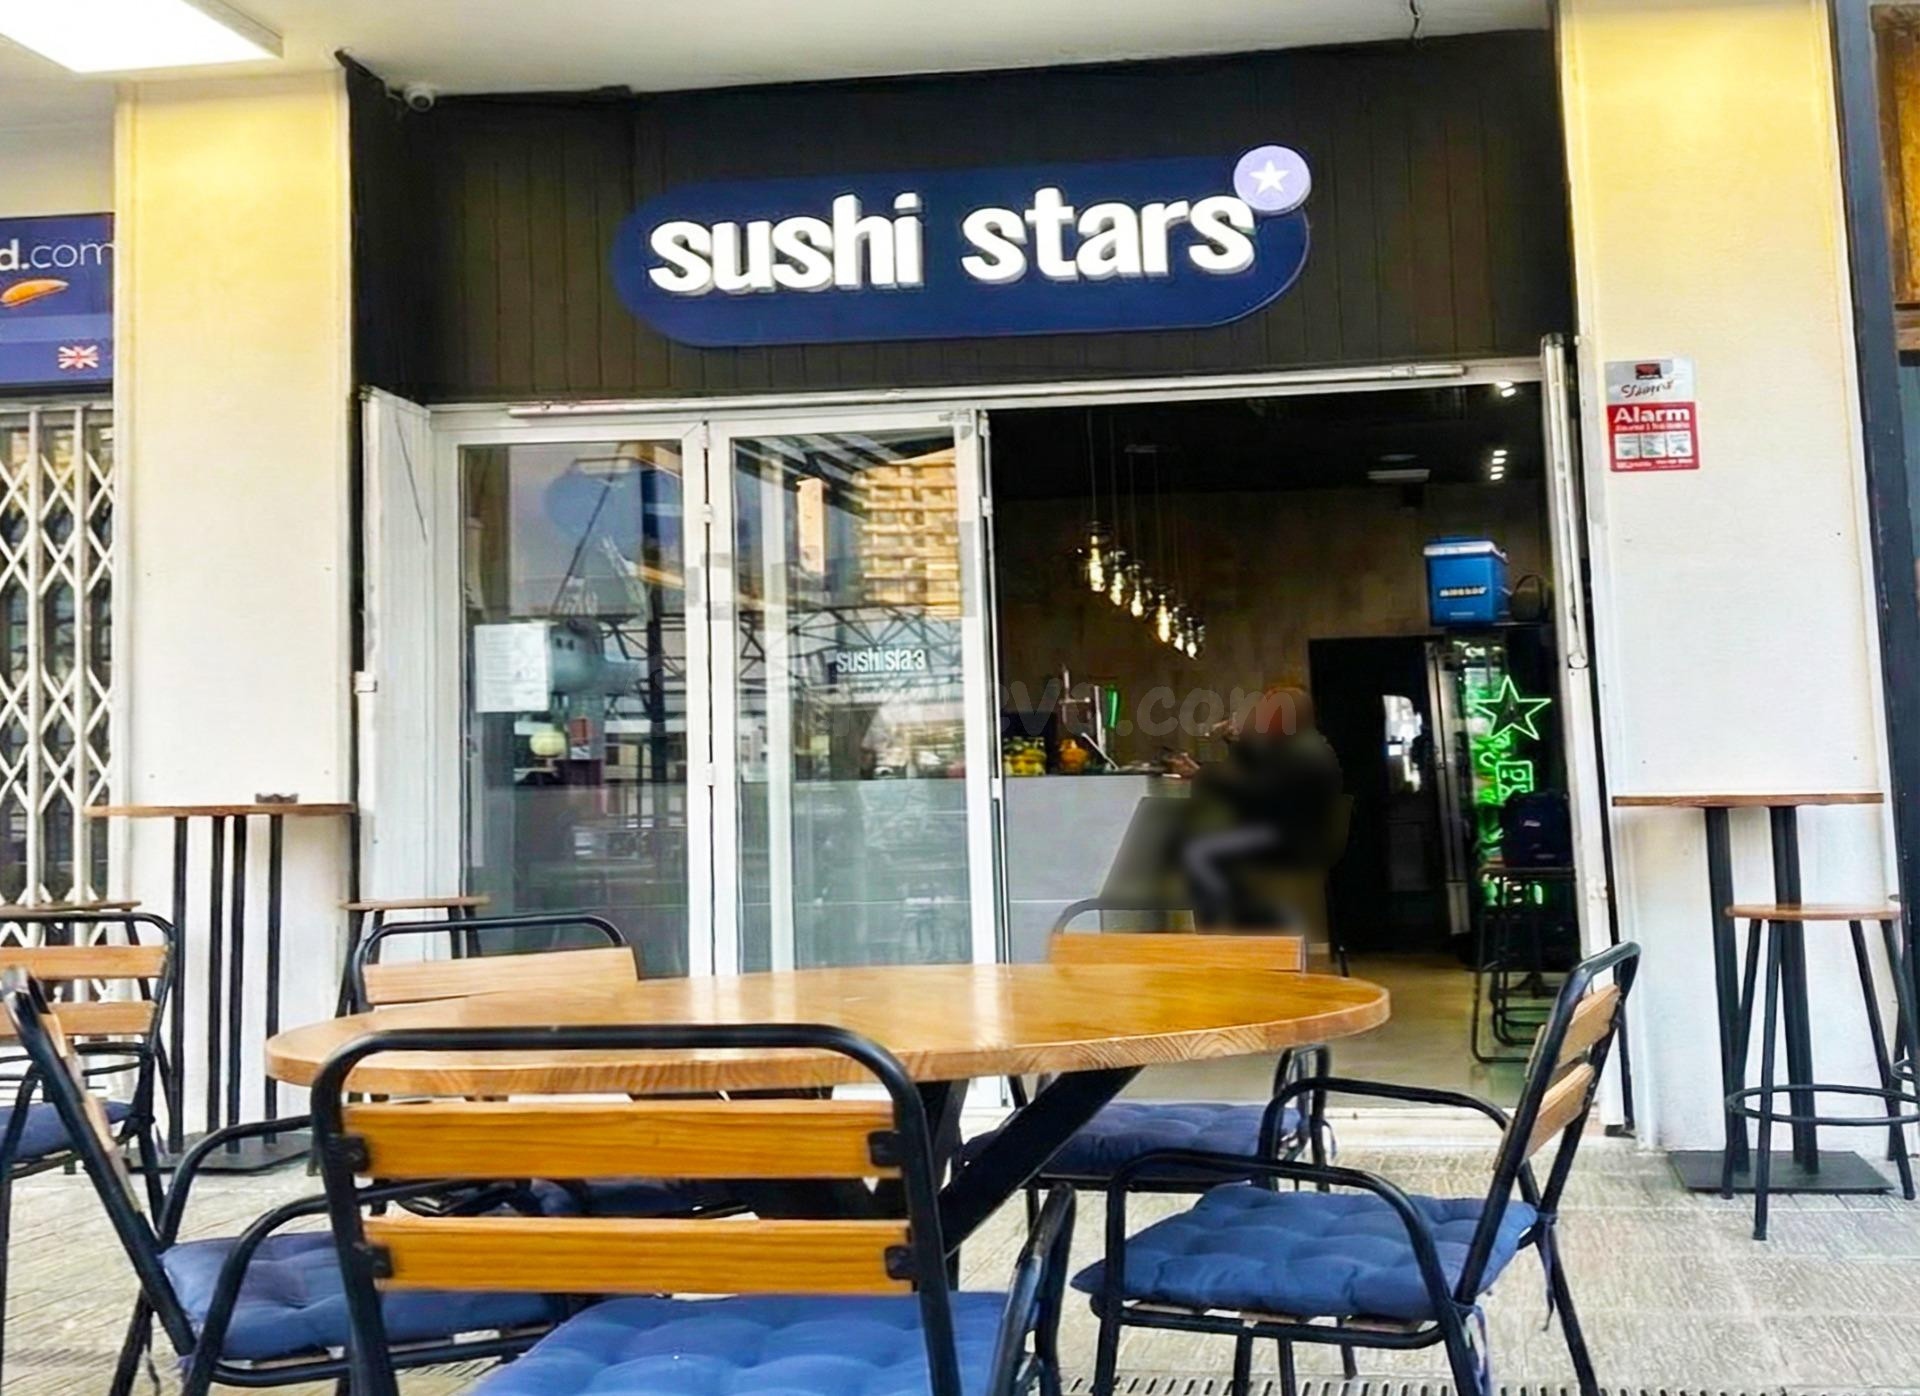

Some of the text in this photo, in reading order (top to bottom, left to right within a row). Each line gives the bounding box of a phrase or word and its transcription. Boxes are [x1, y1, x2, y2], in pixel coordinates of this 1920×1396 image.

[649, 187, 1256, 296] sushi stars
[1615, 406, 1690, 423] Alarm
